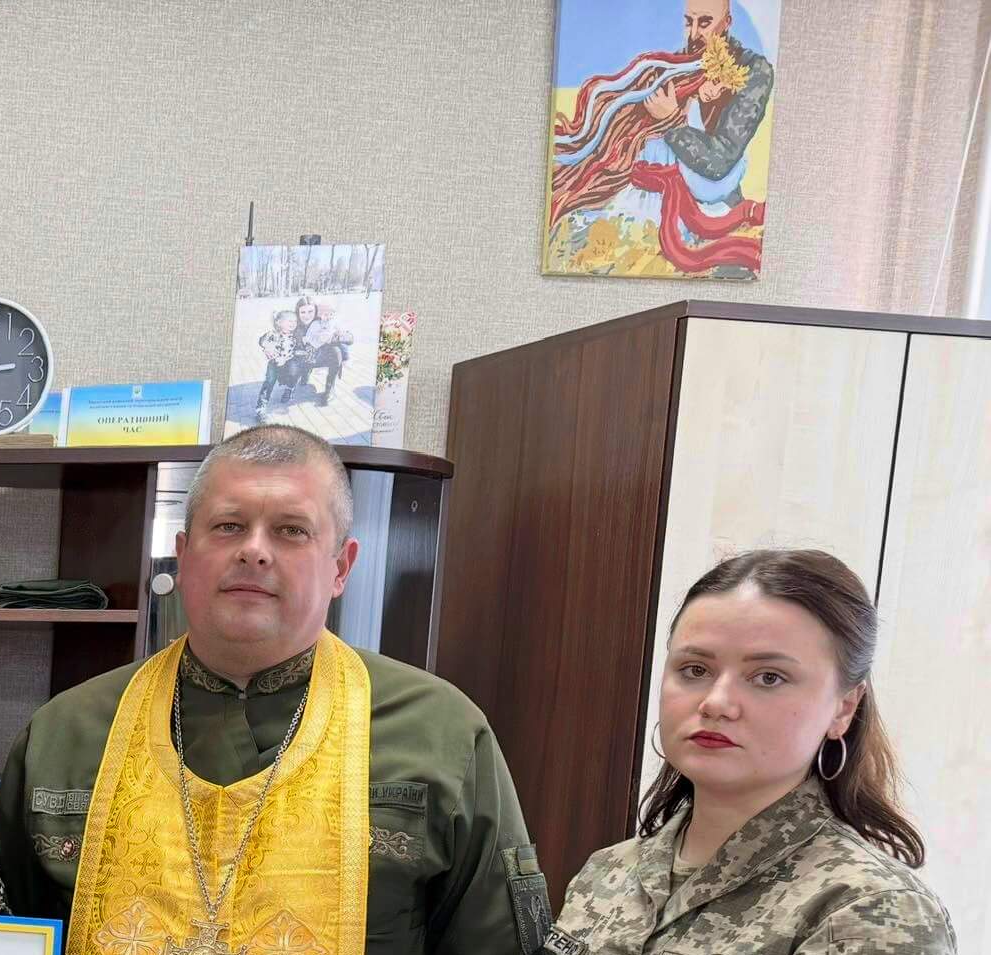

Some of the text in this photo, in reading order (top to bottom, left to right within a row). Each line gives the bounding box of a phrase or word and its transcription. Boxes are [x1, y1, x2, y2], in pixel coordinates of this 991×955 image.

[7, 312, 12, 341] 1
[17, 327, 35, 356] 2
[28, 355, 44, 382] 3
[16, 383, 32, 410] 4
